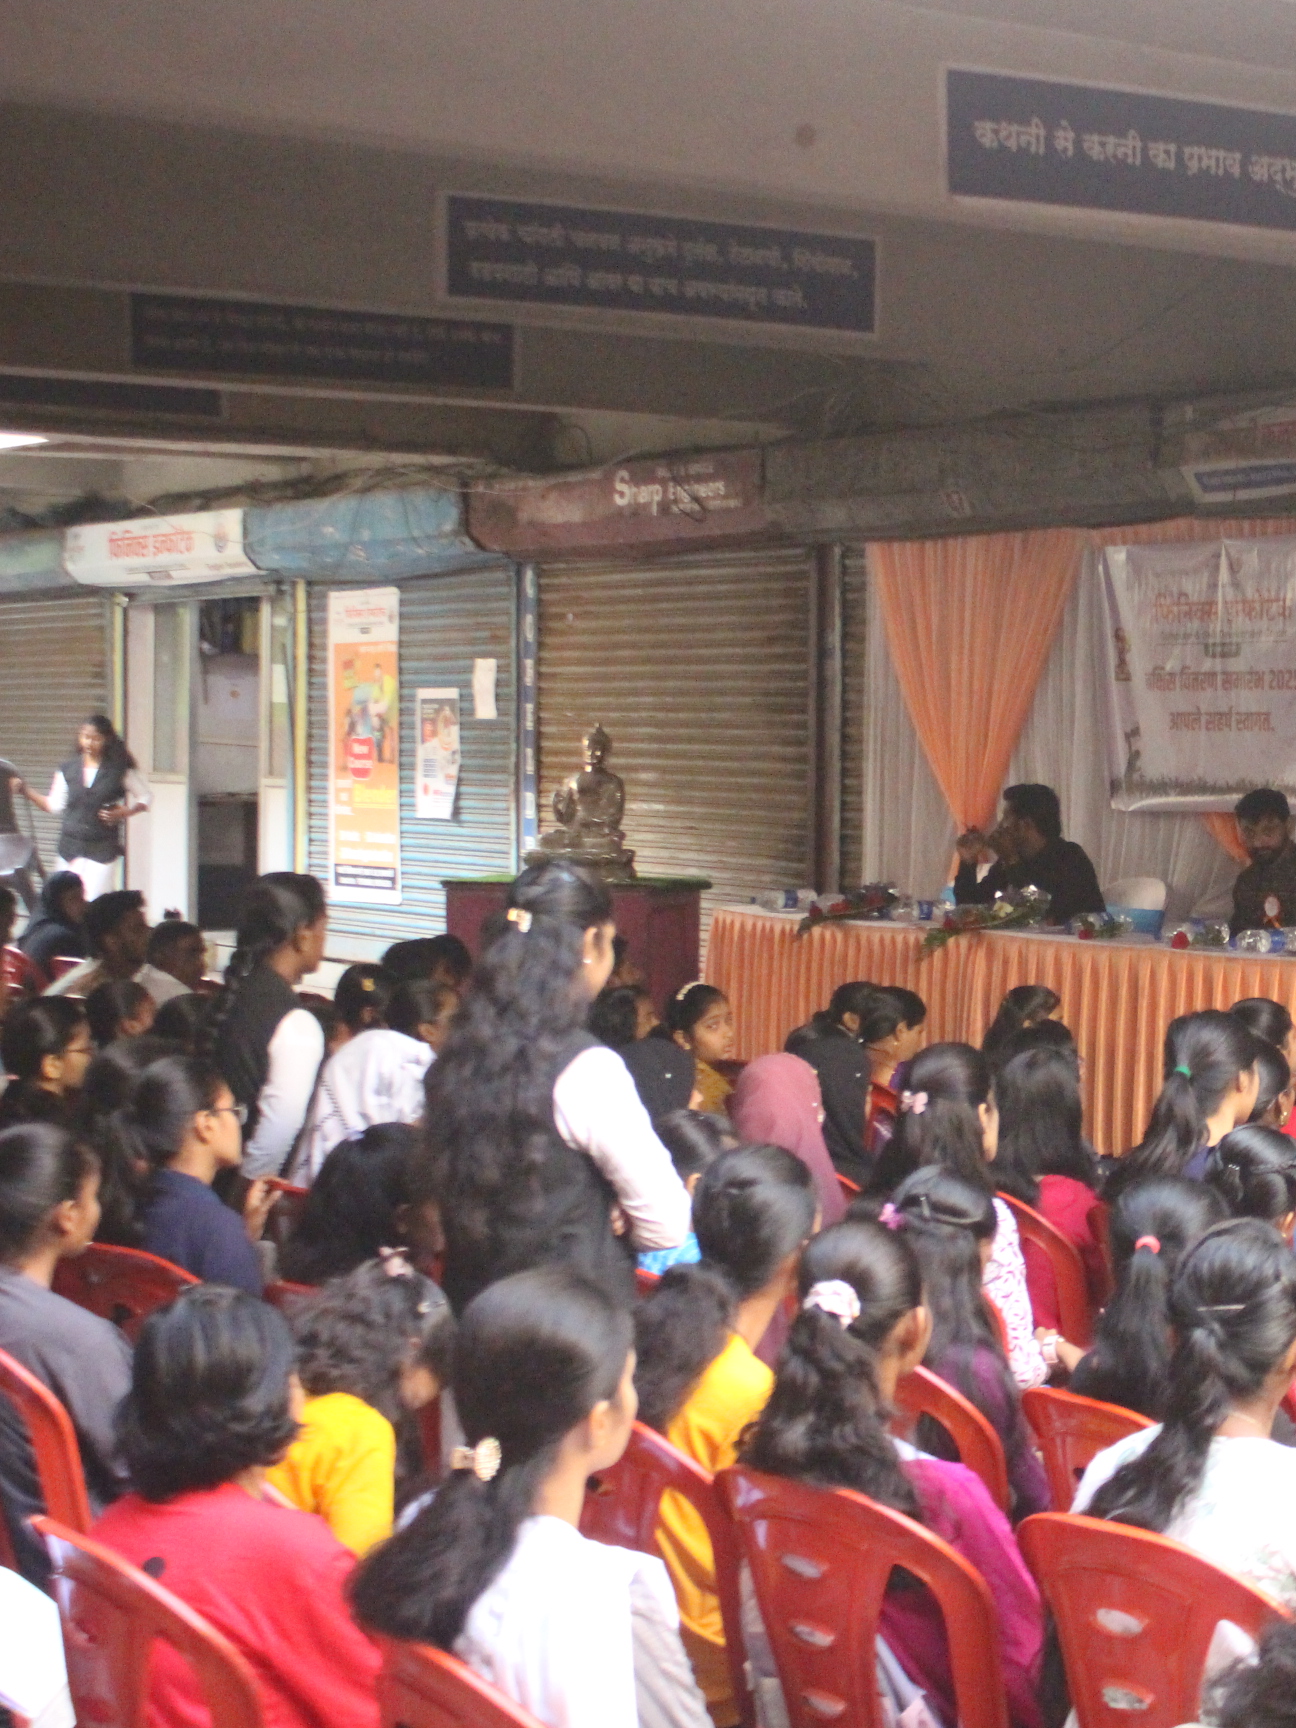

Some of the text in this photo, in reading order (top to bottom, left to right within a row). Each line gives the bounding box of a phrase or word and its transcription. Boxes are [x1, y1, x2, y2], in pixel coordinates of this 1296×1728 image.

[974, 116, 1046, 156] कथनी
[1053, 119, 1076, 158] से
[1083, 130, 1141, 168] करनी
[1148, 141, 1176, 170] का
[1184, 145, 1242, 179] प्रभाव
[1179, 665, 1218, 691] वितरण
[1220, 666, 1265, 691] समारंभ
[1169, 705, 1203, 731] आपले
[1204, 705, 1234, 731] सहर्ष
